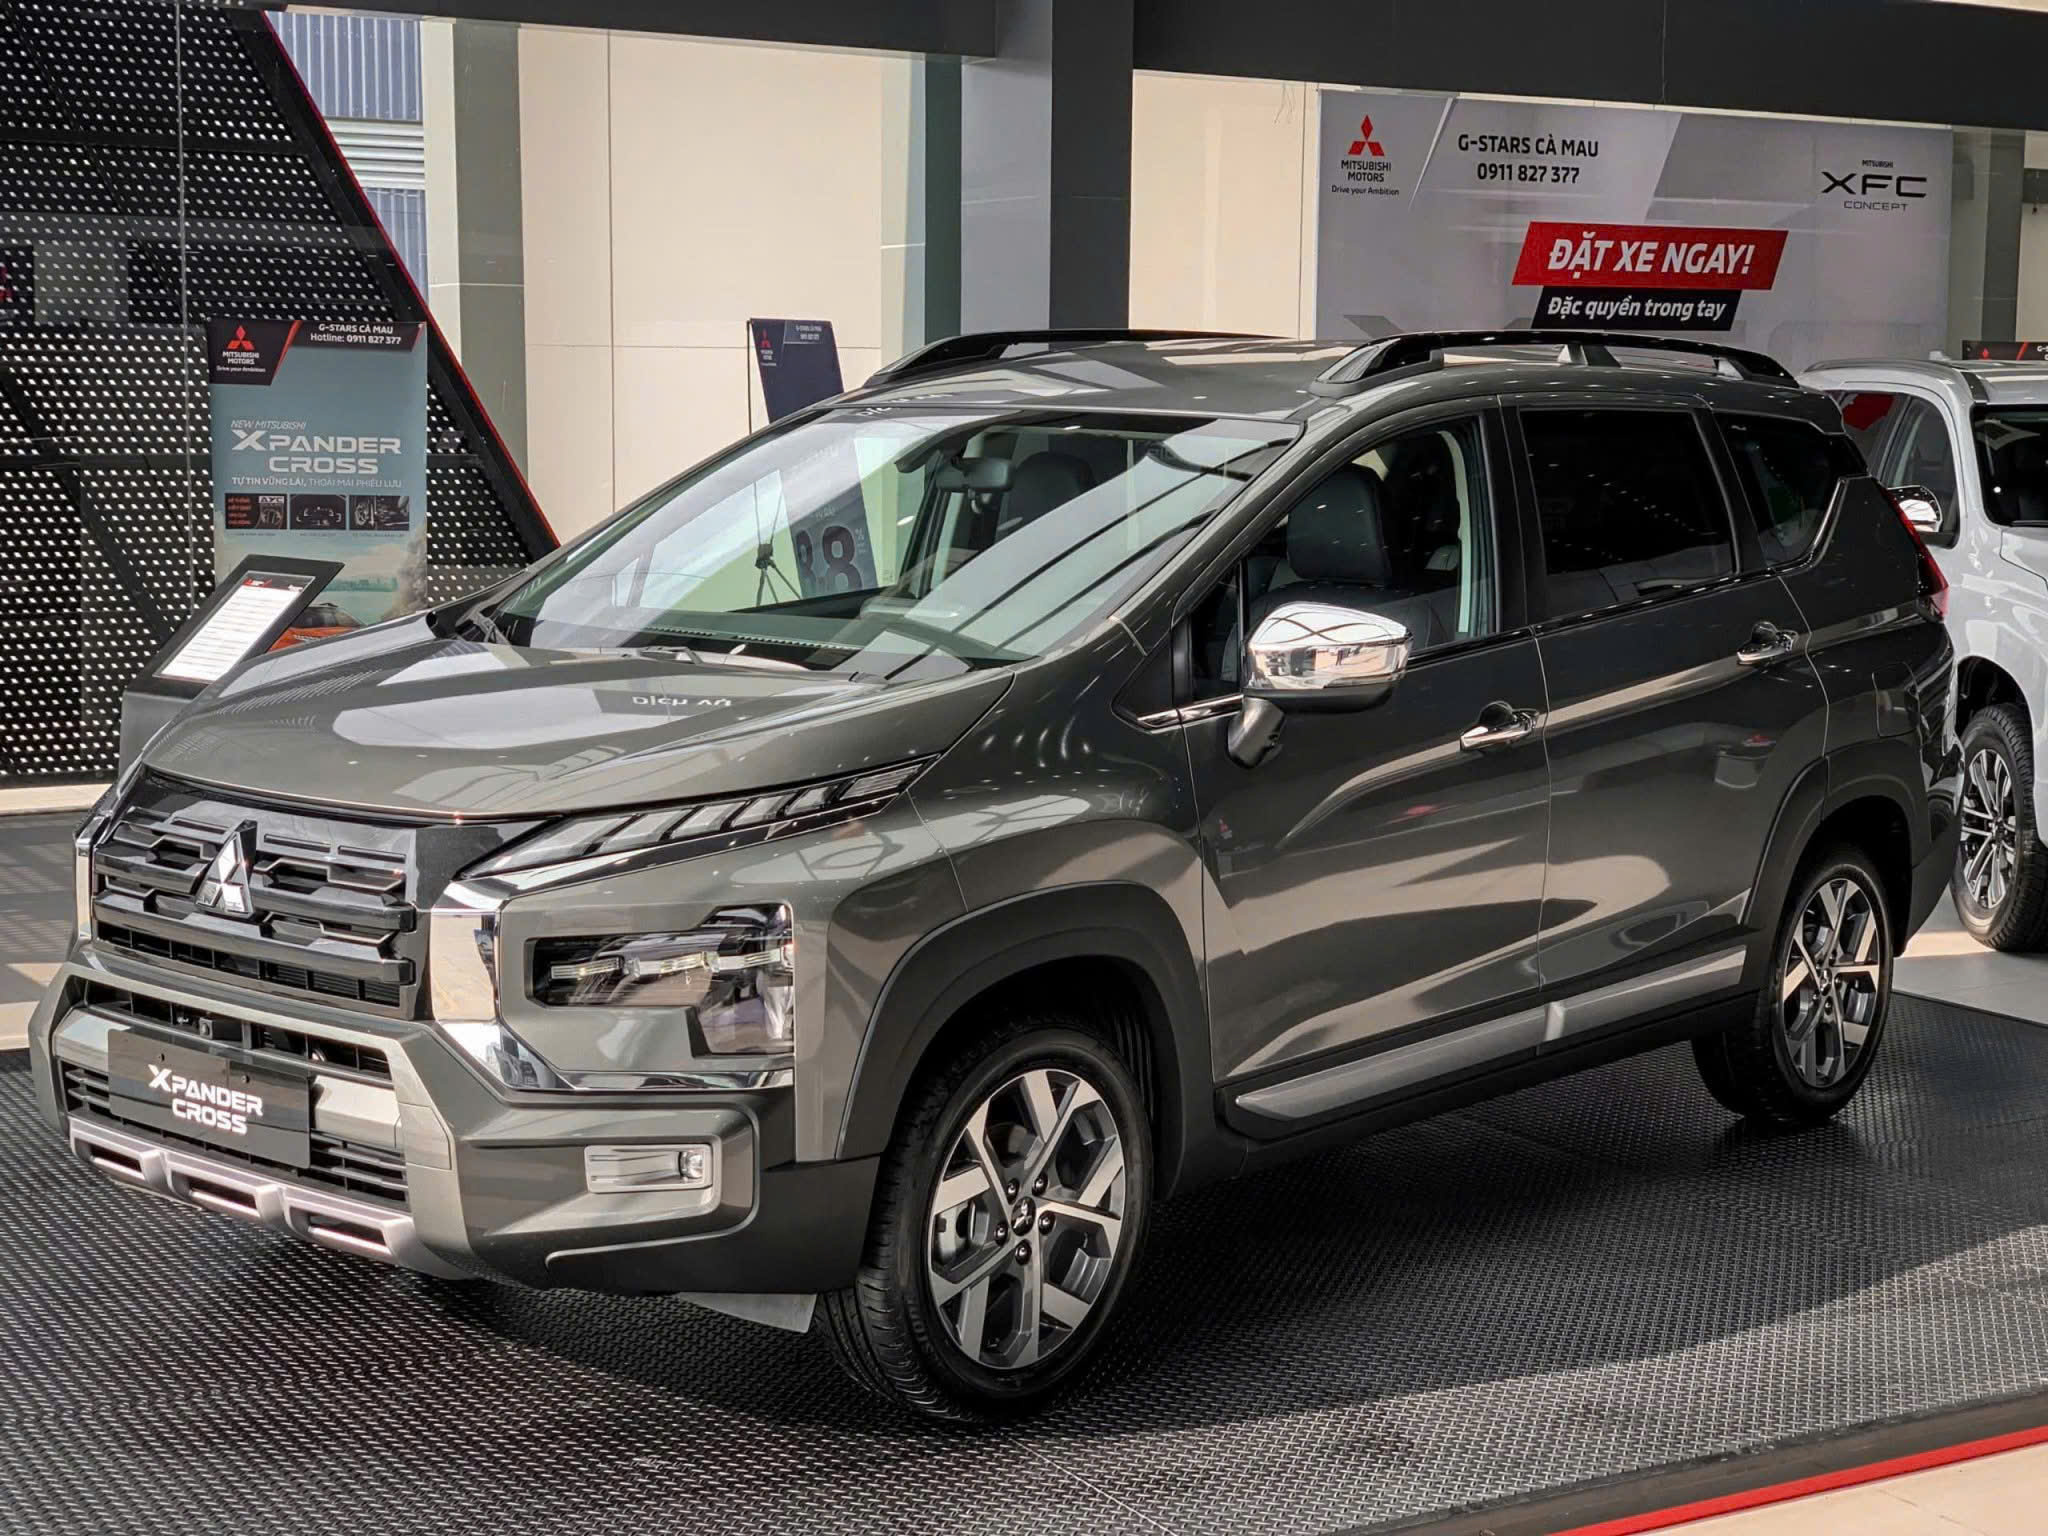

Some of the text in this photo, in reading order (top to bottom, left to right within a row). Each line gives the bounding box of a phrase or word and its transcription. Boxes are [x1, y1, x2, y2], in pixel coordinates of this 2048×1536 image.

[1458, 133, 1599, 157] G-STARS CÀ MAU
[1340, 160, 1392, 172] MITSUBISHI
[1477, 163, 1580, 184] 0911 827 377
[1347, 171, 1385, 183] MOTORS
[1821, 171, 1927, 198] XFC
[1331, 185, 1400, 197] Drive your Ambition
[1843, 200, 1909, 212] CONCEPT
[1547, 231, 1755, 279] ĐẶT XE NGAY!
[1547, 295, 1727, 321] Đặc quyền trong tay
[318, 323, 394, 334] G-STARS CÀ MAU
[310, 333, 401, 345] Hotline: 0911 827 377
[222, 351, 260, 359] MITSUBISHI
[227, 358, 255, 366] MOTORS
[231, 420, 307, 430] NEW MITSUBISHI
[231, 429, 402, 455] XPANDER
[269, 456, 379, 475] CROSS
[148, 1063, 263, 1116] XPANDER
[172, 1098, 248, 1135] CROSS
